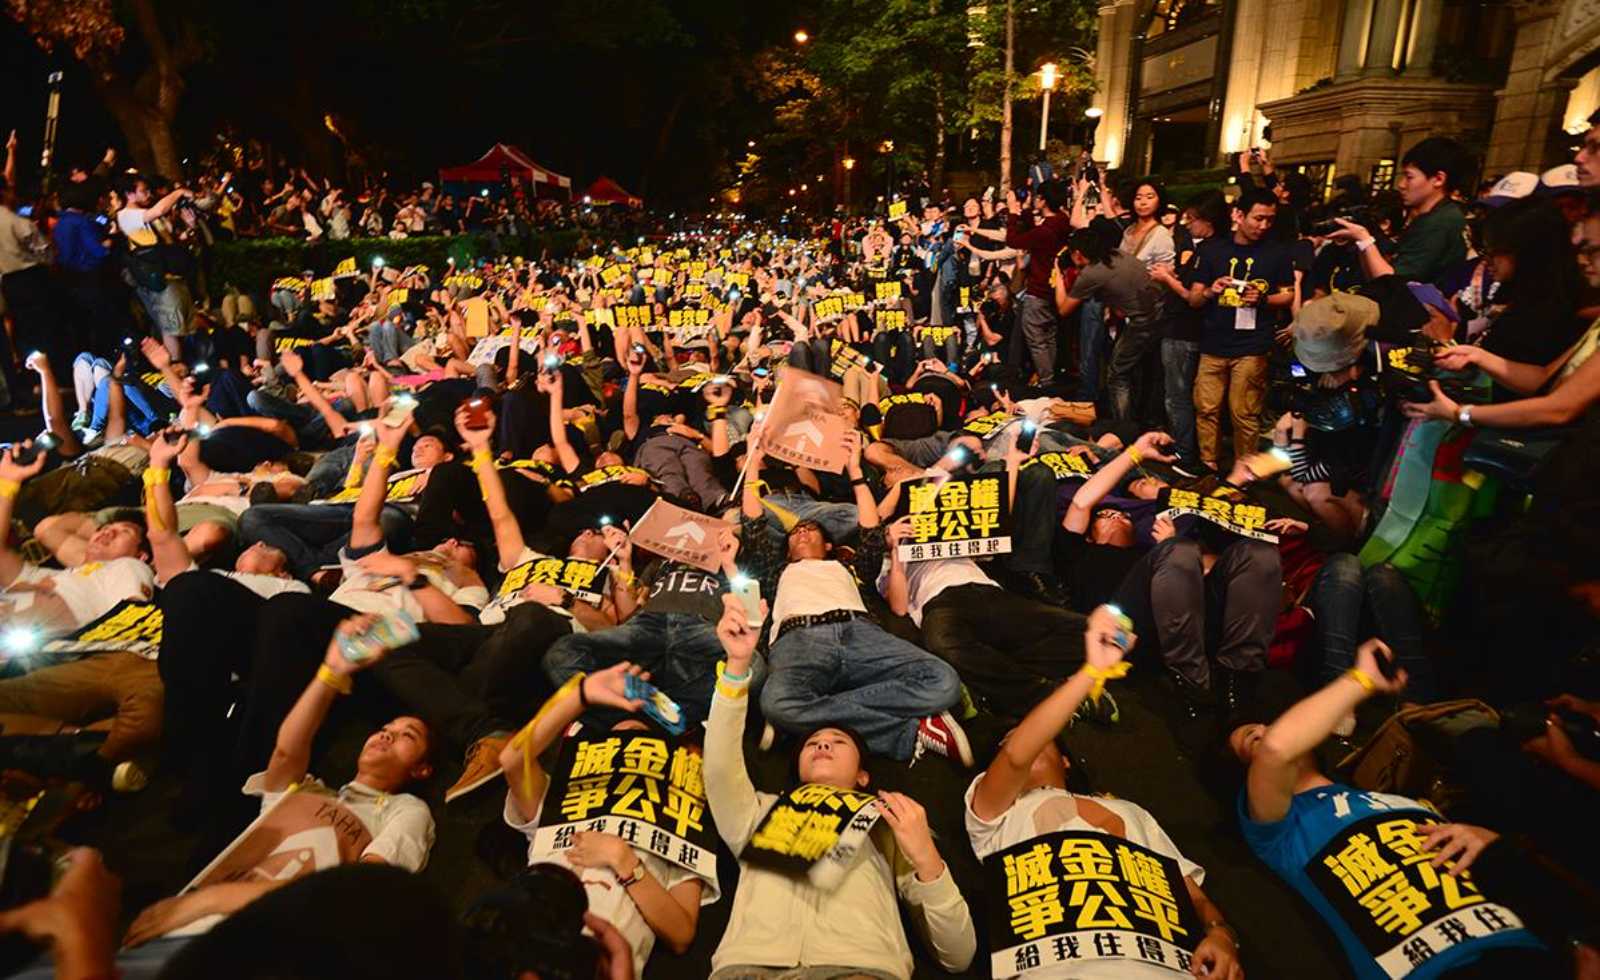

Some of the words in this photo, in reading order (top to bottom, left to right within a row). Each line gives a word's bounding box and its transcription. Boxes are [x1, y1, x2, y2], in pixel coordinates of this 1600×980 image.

[315, 802, 362, 844] TAHA
[560, 774, 705, 838] 爭公平
[1002, 838, 1176, 902] 滅金權
[1007, 880, 1189, 942] 爭公平
